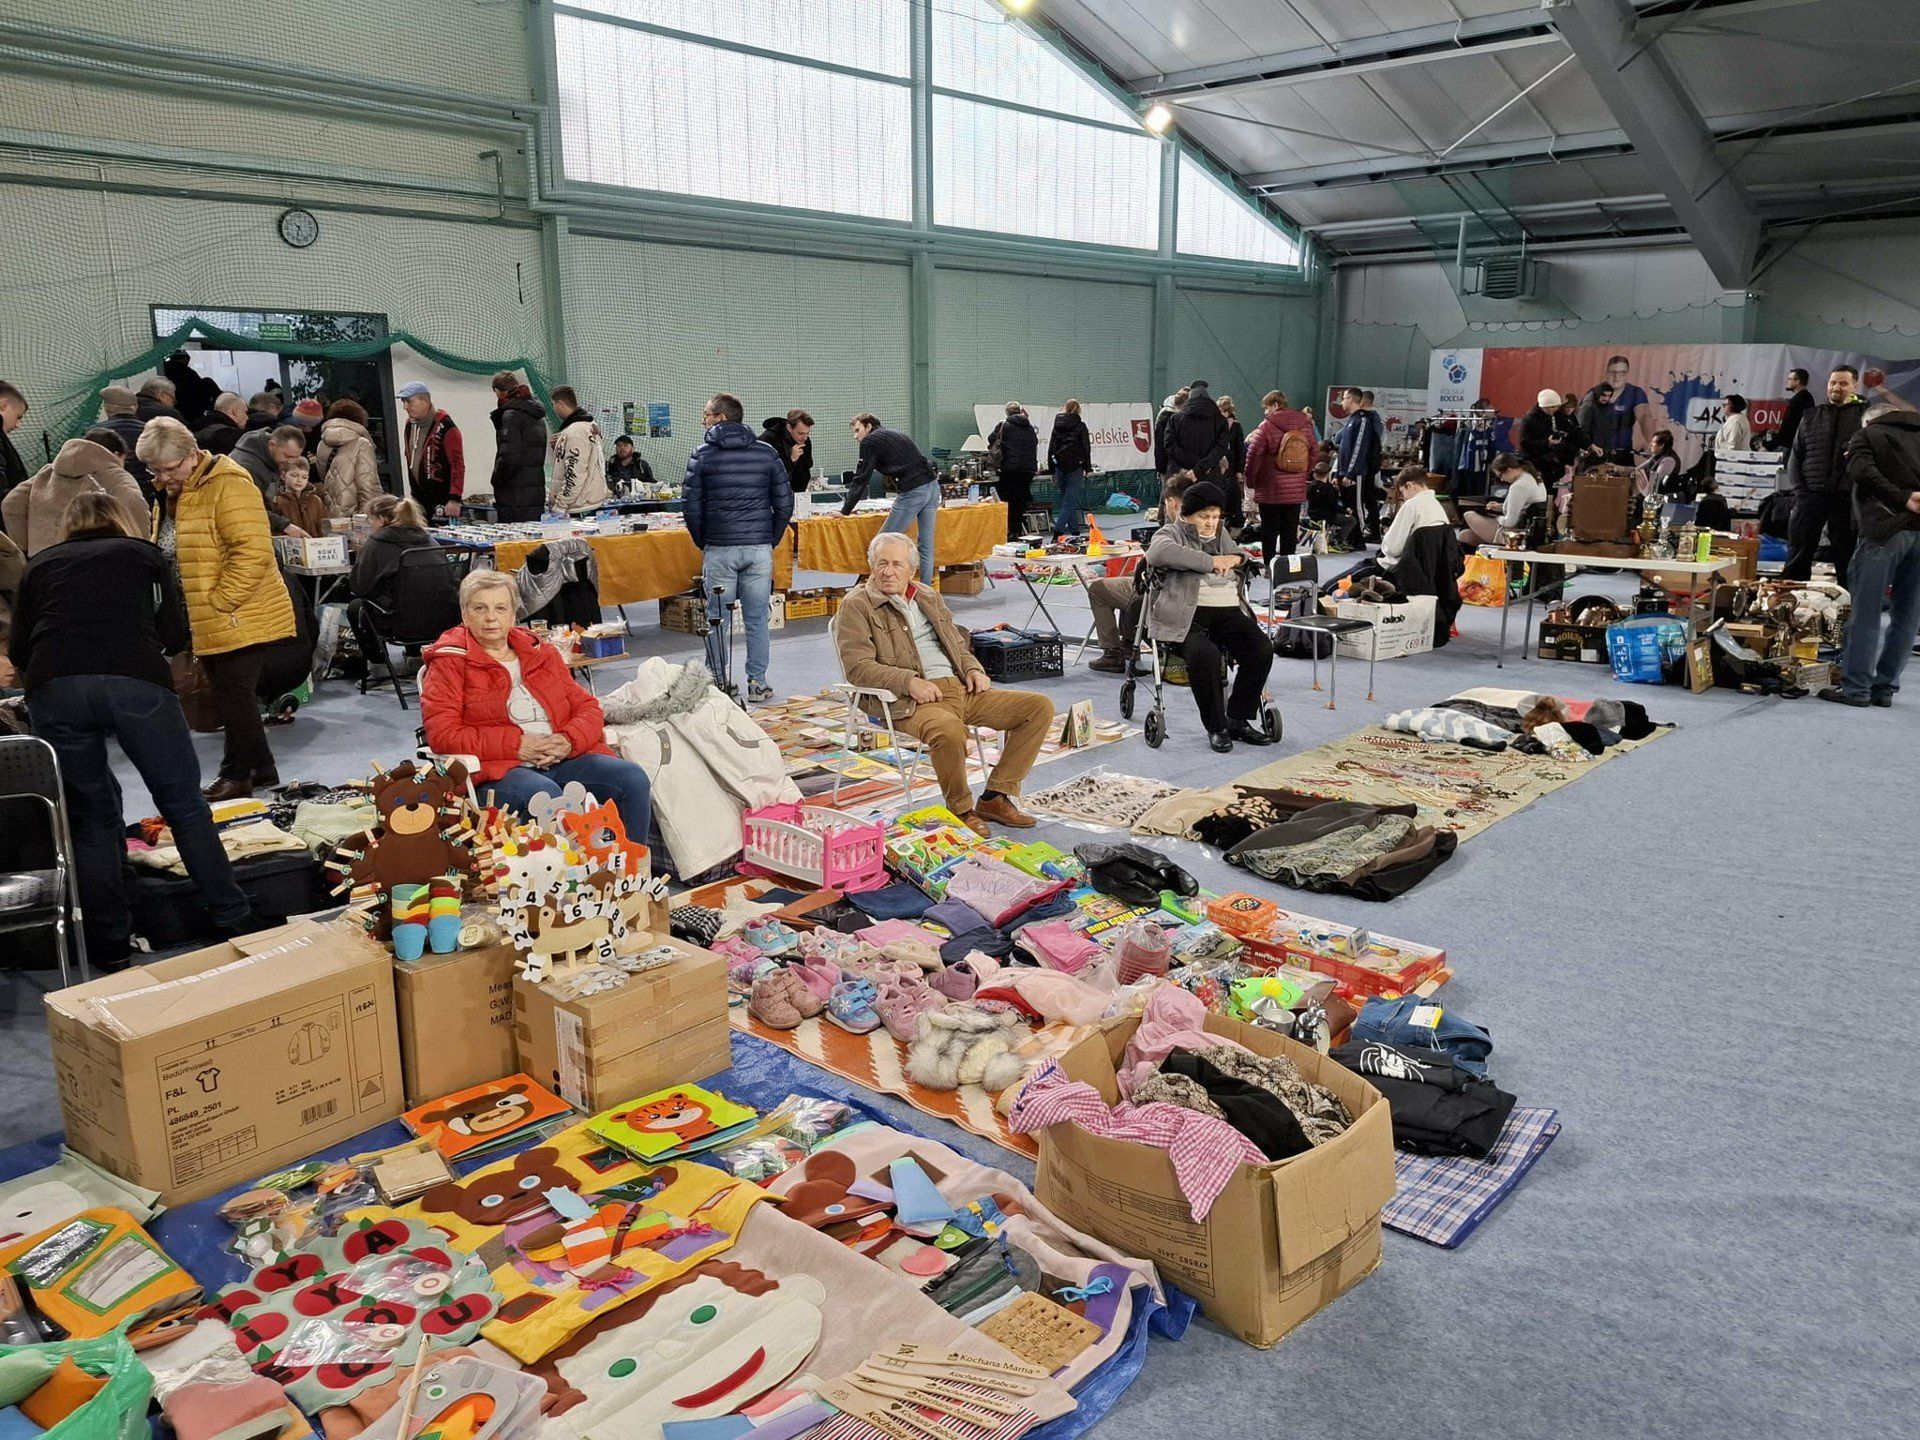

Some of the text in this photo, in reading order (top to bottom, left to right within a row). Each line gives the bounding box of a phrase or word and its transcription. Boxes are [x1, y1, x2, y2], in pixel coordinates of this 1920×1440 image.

[614, 855, 621, 868] E
[526, 891, 536, 903] 4
[550, 881, 563, 894] 5
[594, 903, 603, 916] 7
[514, 929, 528, 943] 2
[600, 939, 612, 958] 10
[165, 1086, 188, 1100] F&L
[167, 1106, 180, 1116] PL
[365, 1230, 397, 1254] A
[273, 1260, 301, 1282] Y
[312, 1283, 341, 1305] Y
[446, 1302, 472, 1326] U
[960, 1354, 1034, 1375] Kochana Mama
[949, 1371, 1018, 1390] Kochana Babcia
[915, 1393, 983, 1423] Kochana Mama
[865, 1410, 908, 1439] Kochana
[900, 1408, 932, 1428] Kochana
